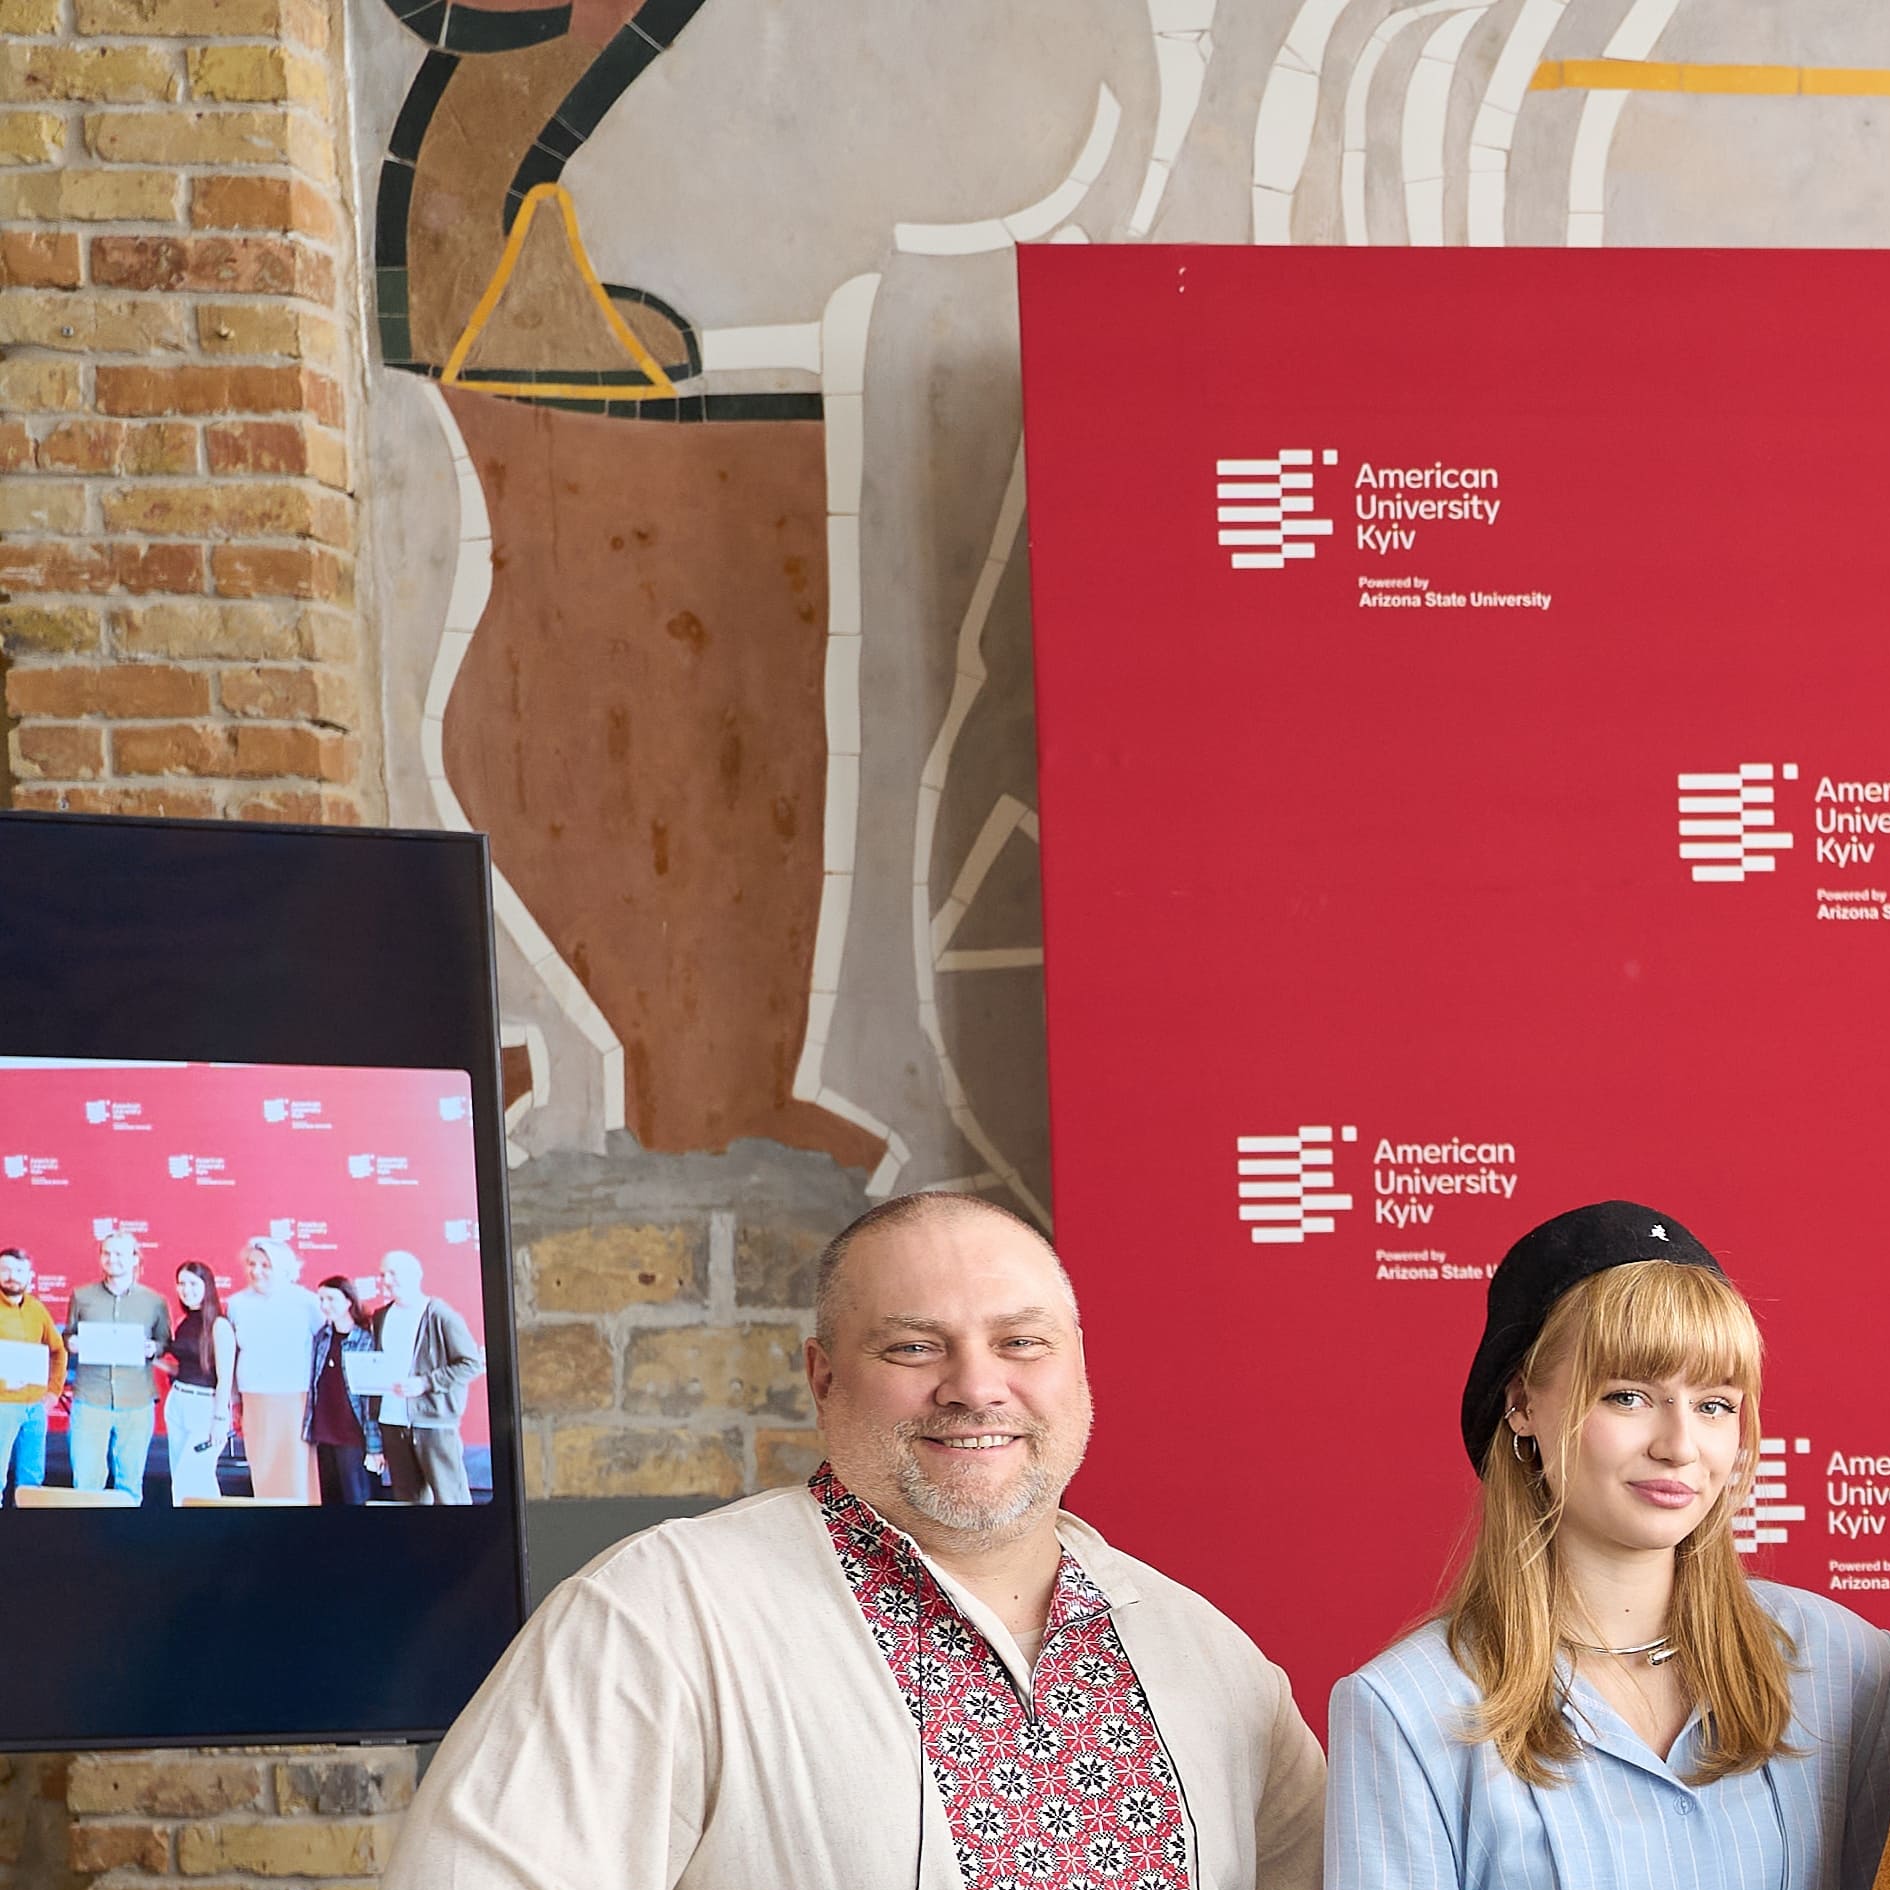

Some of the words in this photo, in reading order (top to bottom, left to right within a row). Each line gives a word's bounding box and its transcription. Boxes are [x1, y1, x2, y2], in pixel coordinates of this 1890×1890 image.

[1355, 462, 1498, 488] American
[1356, 493, 1500, 524] University
[1356, 523, 1413, 554] Kyiv
[1359, 577, 1411, 589] Powered
[1414, 577, 1428, 590] by
[1360, 592, 1421, 608] Arizona
[1425, 592, 1466, 608] State
[1471, 592, 1551, 610] University
[1816, 836, 1873, 867] Kyiv
[1817, 889, 1869, 901] Powered
[1872, 889, 1886, 902] by
[1817, 904, 1878, 920] Arizona
[1374, 1138, 1515, 1164] American
[1375, 1168, 1517, 1199] University
[1375, 1197, 1432, 1228] Kyiv
[1376, 1250, 1428, 1262] Powered
[1431, 1250, 1445, 1263] by
[1377, 1264, 1438, 1279] Arizona
[1442, 1264, 1483, 1279] State
[1828, 1508, 1885, 1539] Kyiv
[1829, 1561, 1881, 1572] Powered
[1830, 1575, 1890, 1589] Arizona
